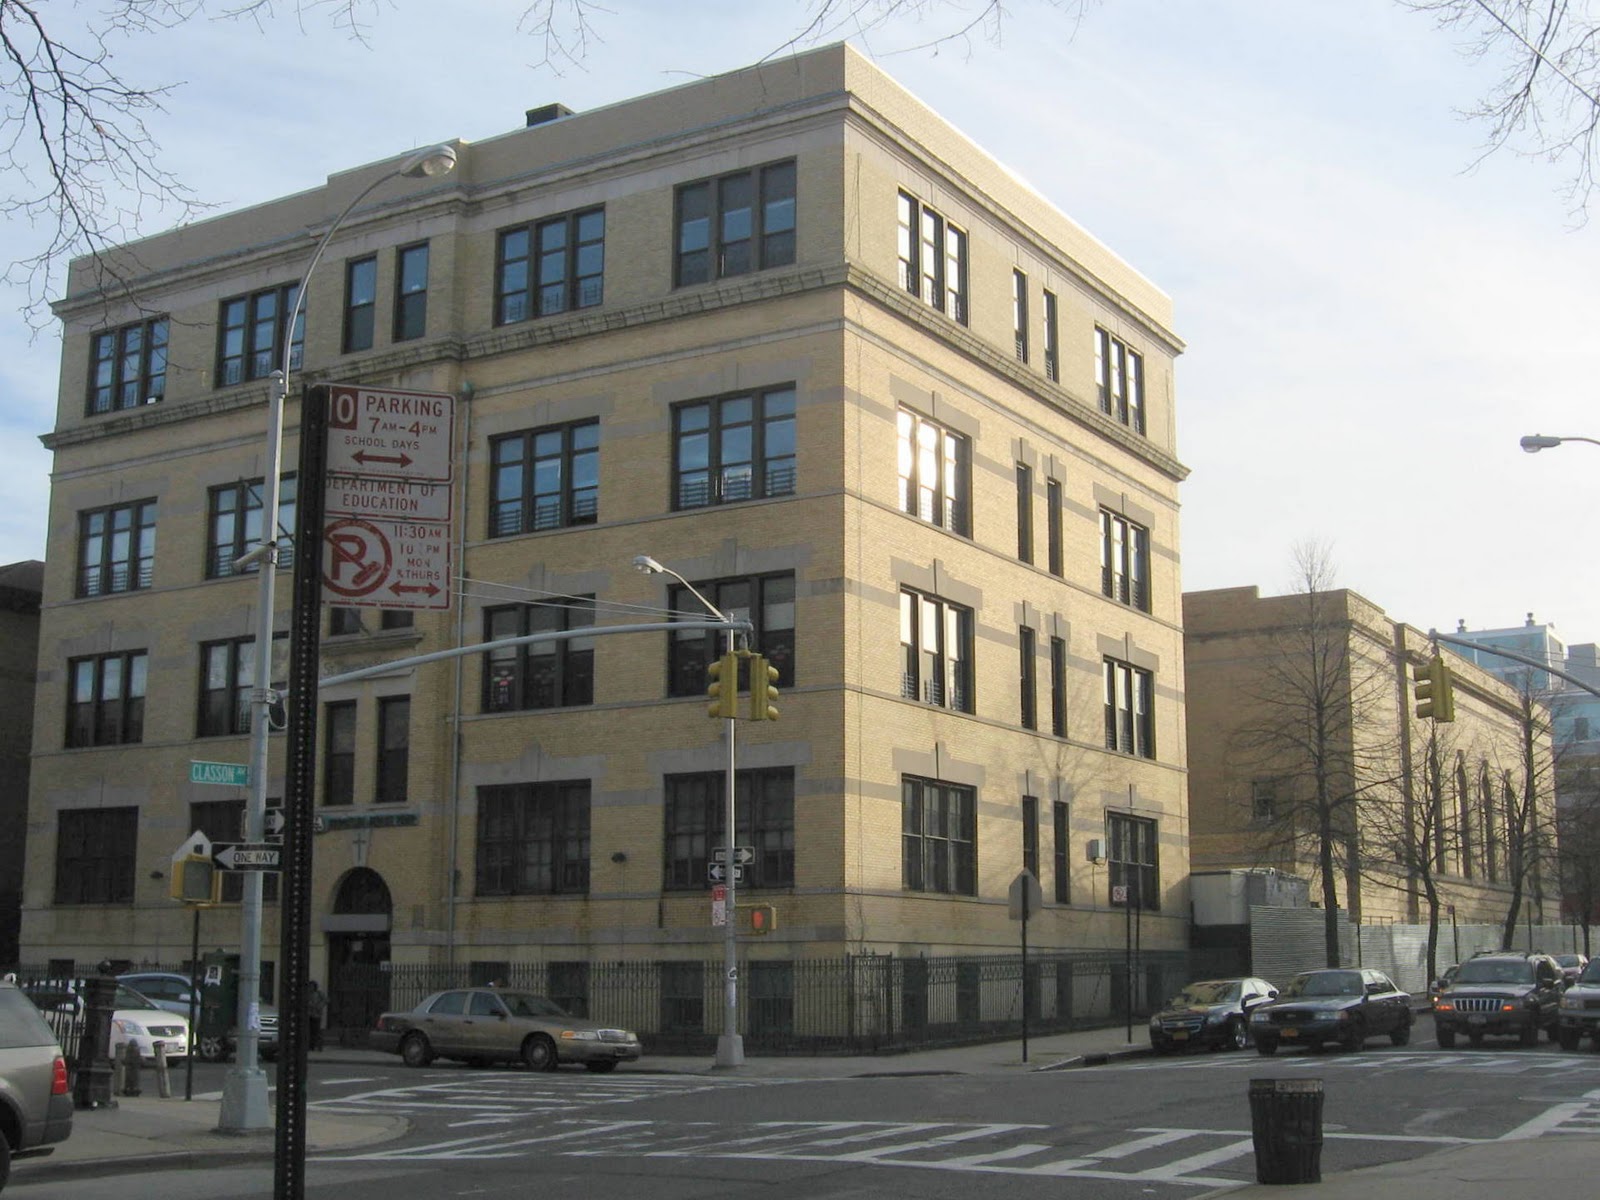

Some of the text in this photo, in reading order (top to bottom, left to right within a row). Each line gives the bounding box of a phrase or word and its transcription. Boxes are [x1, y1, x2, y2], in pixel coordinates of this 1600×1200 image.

[366, 396, 443, 417] PARKING
[344, 435, 420, 450] SCHOOL DAYS
[325, 478, 437, 497] DEPARTMENT OF
[343, 493, 418, 511] EDUCATION
[407, 558, 430, 568] MON
[192, 764, 234, 782] CLASSON
[233, 852, 276, 863] ONE WAY
